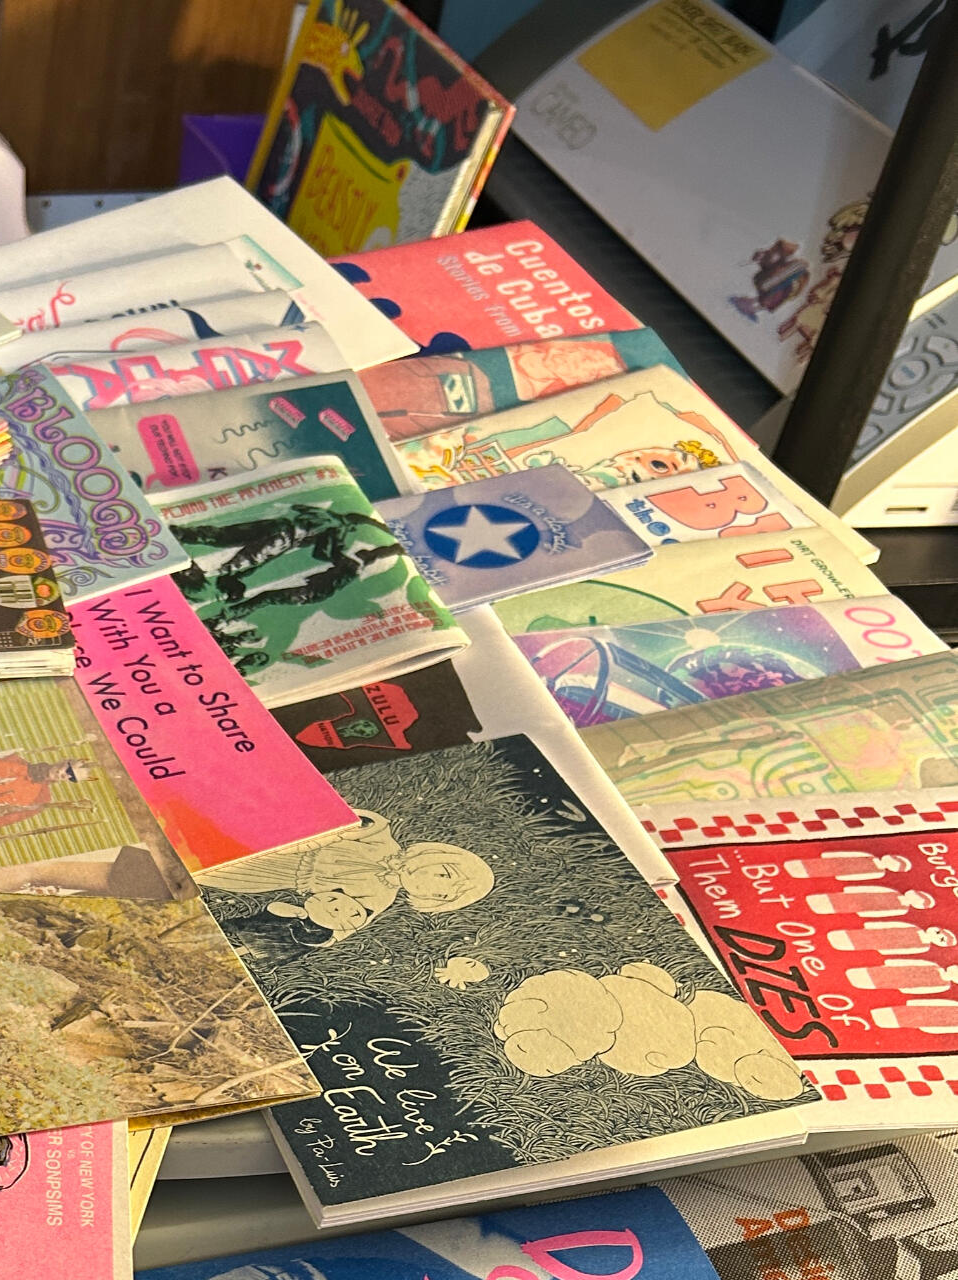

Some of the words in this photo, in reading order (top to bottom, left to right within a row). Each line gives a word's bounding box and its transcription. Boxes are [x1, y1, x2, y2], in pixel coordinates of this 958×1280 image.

[437, 254, 490, 302] Stories
[485, 305, 522, 337] from
[464, 251, 503, 276] de
[497, 280, 563, 338] Cuba
[505, 240, 605, 330] Cuentos
[790, 539, 815, 563] DIRT
[124, 588, 154, 597] I
[87, 598, 139, 651] With
[123, 654, 162, 695] You
[154, 701, 177, 716] a
[137, 601, 193, 658] Want
[176, 664, 204, 686] to
[365, 685, 401, 726] ZULU
[87, 671, 126, 711] We
[117, 716, 187, 780] Could
[198, 691, 255, 753] Share
[689, 853, 743, 920] Them
[713, 925, 839, 1049] DIES
[776, 921, 827, 977] One
[817, 994, 871, 1031] Of
[332, 1053, 365, 1081] on
[366, 1037, 419, 1080] We
[396, 1088, 438, 1135] live
[80, 1140, 95, 1159] OF
[294, 1117, 322, 1134] by
[324, 1085, 409, 1156] Earth
[45, 1150, 63, 1226] SONPSIMS
[79, 1160, 94, 1189] NEW
[79, 1192, 95, 1227] YORK
